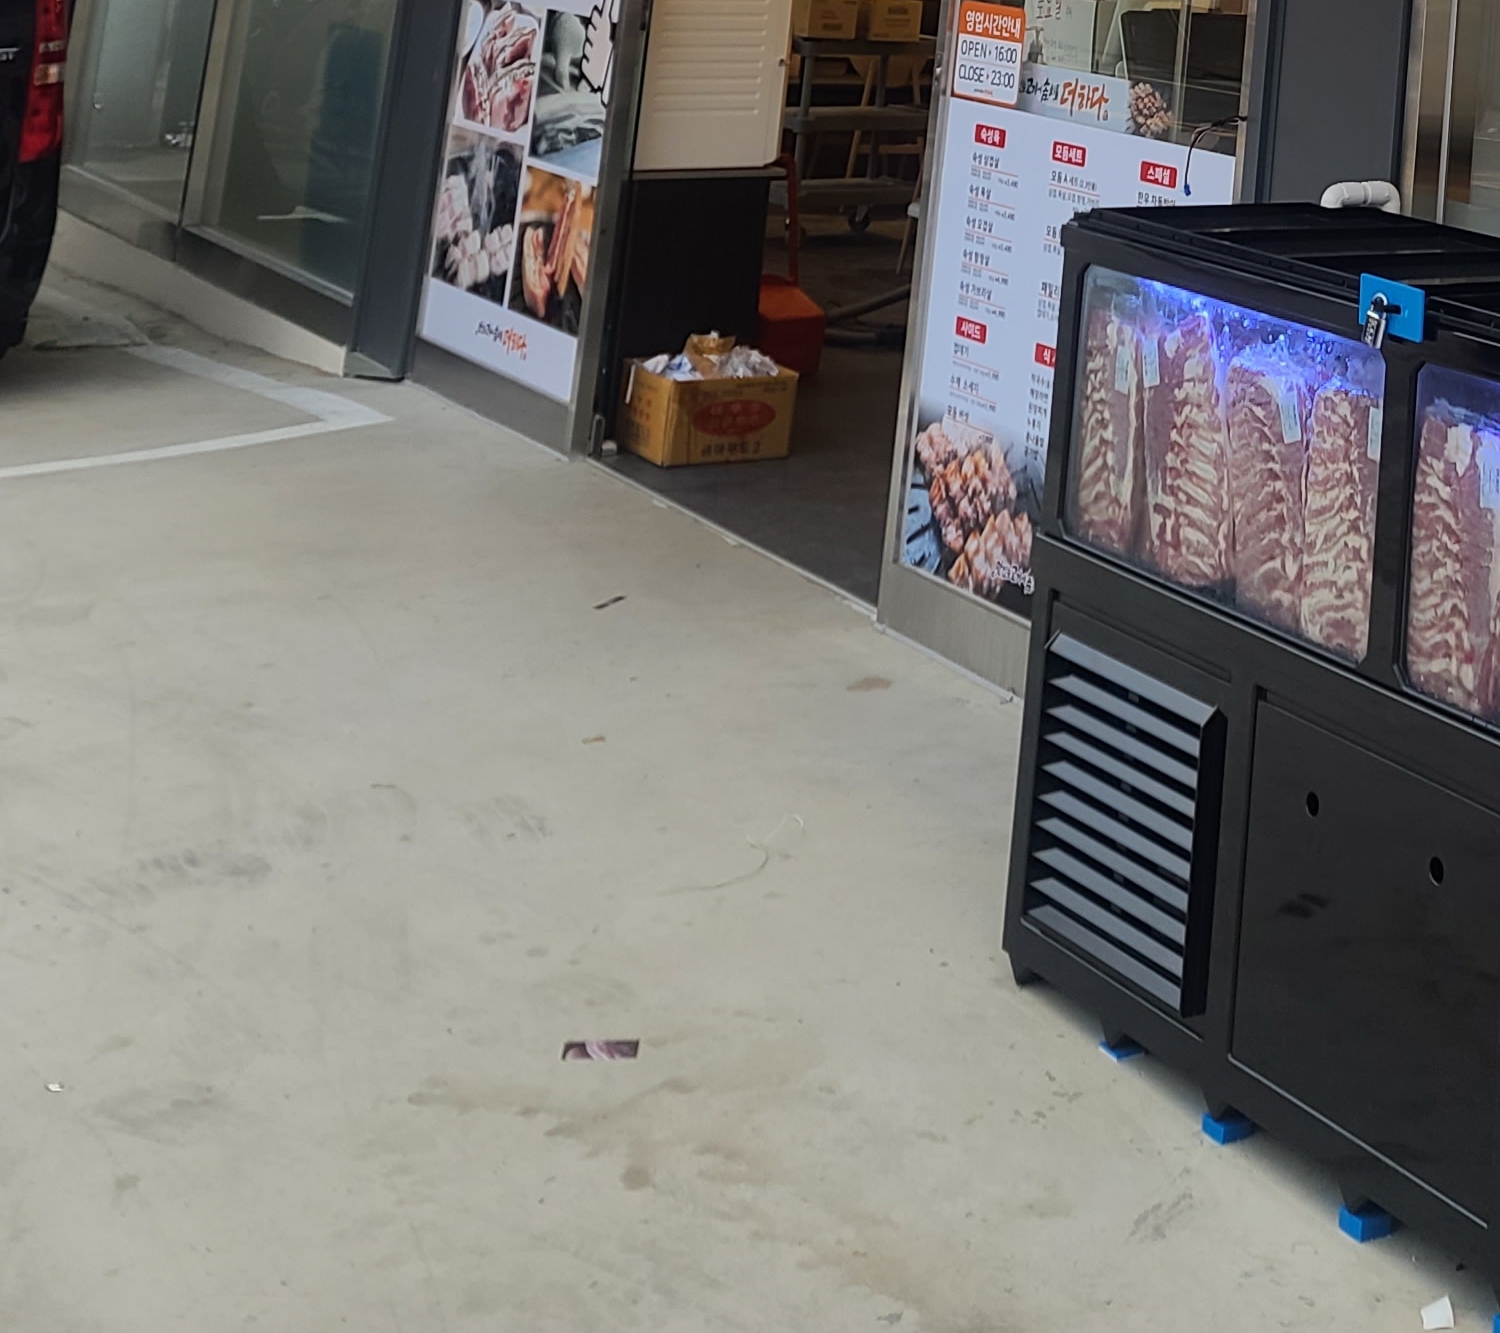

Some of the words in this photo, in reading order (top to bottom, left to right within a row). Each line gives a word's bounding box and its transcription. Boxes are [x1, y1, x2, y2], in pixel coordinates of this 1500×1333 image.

[966, 10, 1021, 39] 영업시간안내
[961, 39, 987, 59] OPEN
[995, 45, 1017, 64] 16:00
[959, 64, 984, 83] CLOSE
[991, 70, 1015, 89] 23:00
[1060, 78, 1109, 121] 더하다
[961, 321, 981, 339] 사이드
